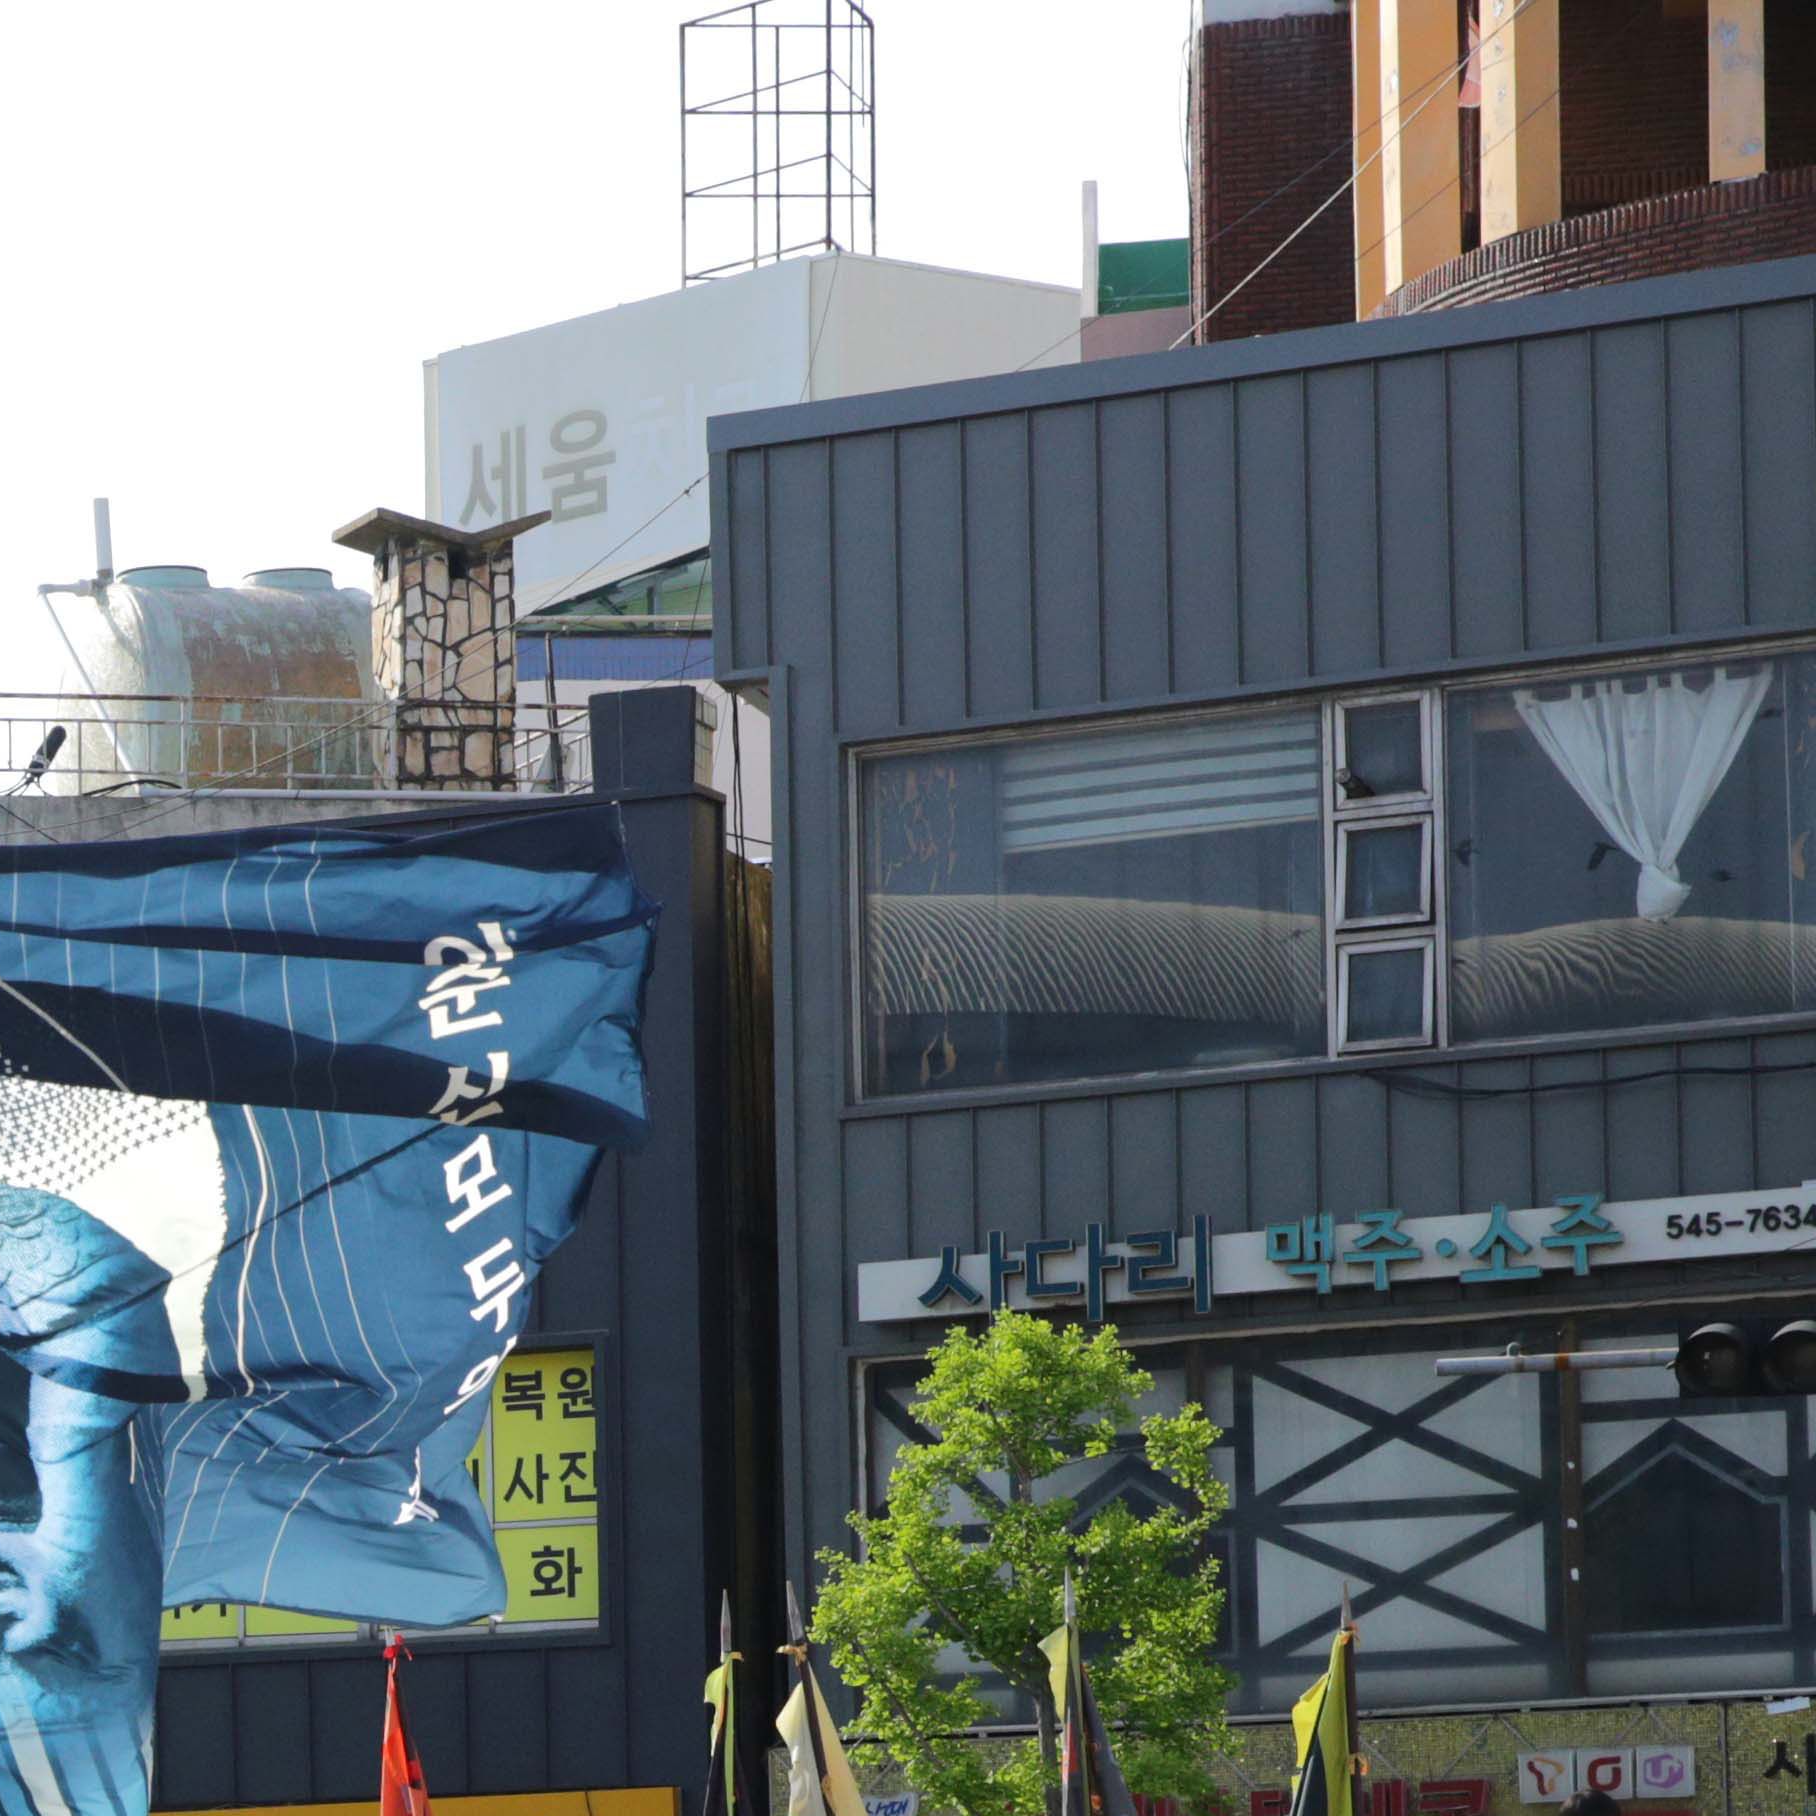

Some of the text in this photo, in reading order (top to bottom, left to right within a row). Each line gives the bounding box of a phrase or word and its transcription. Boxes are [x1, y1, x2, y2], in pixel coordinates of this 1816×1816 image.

[458, 408, 617, 528] 세움
[916, 1213, 1212, 1322] 사다리
[1265, 1193, 1624, 1294] 맥주·소주
[502, 1365, 596, 1421] 복원
[503, 1451, 597, 1506] 사진
[530, 1545, 583, 1598] 화
